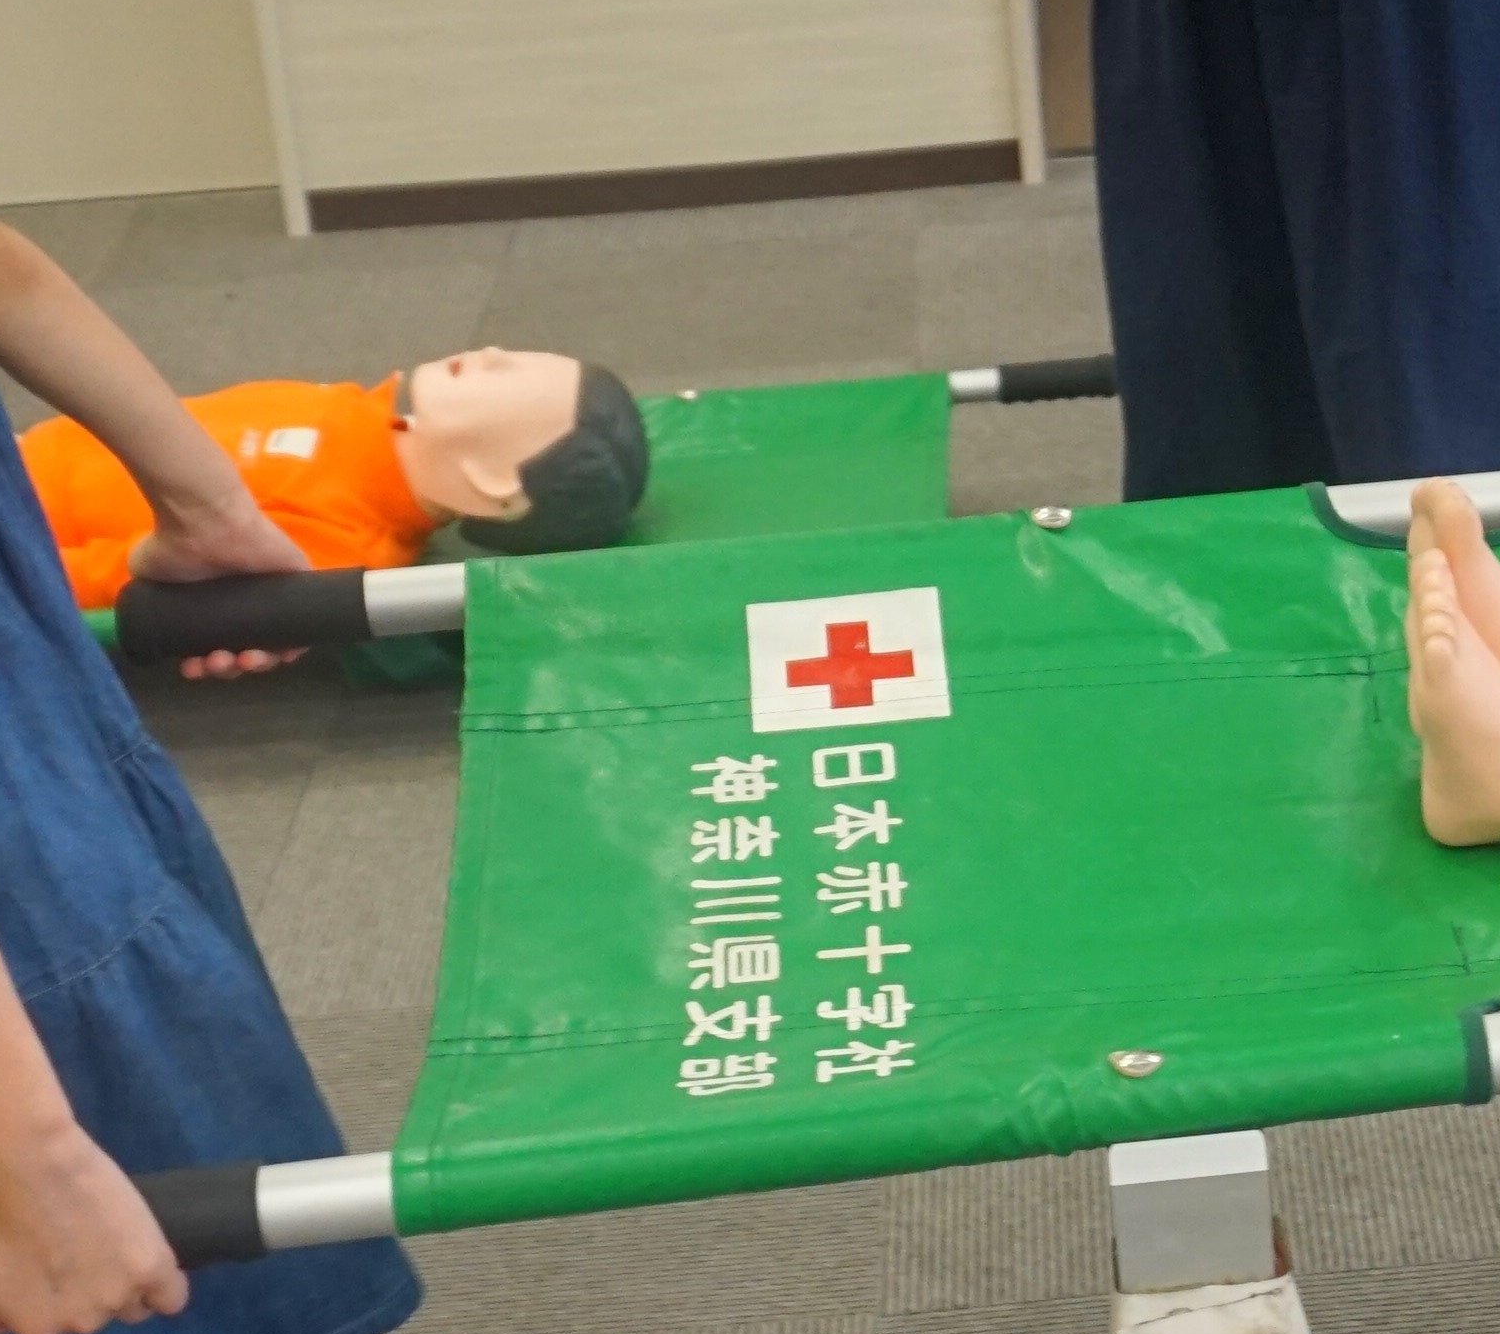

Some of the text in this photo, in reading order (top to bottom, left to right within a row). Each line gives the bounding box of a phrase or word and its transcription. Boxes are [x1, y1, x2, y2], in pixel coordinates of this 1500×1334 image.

[676, 754, 782, 1096] 神奈川県支部
[811, 742, 915, 1083] 日本赤十字社
